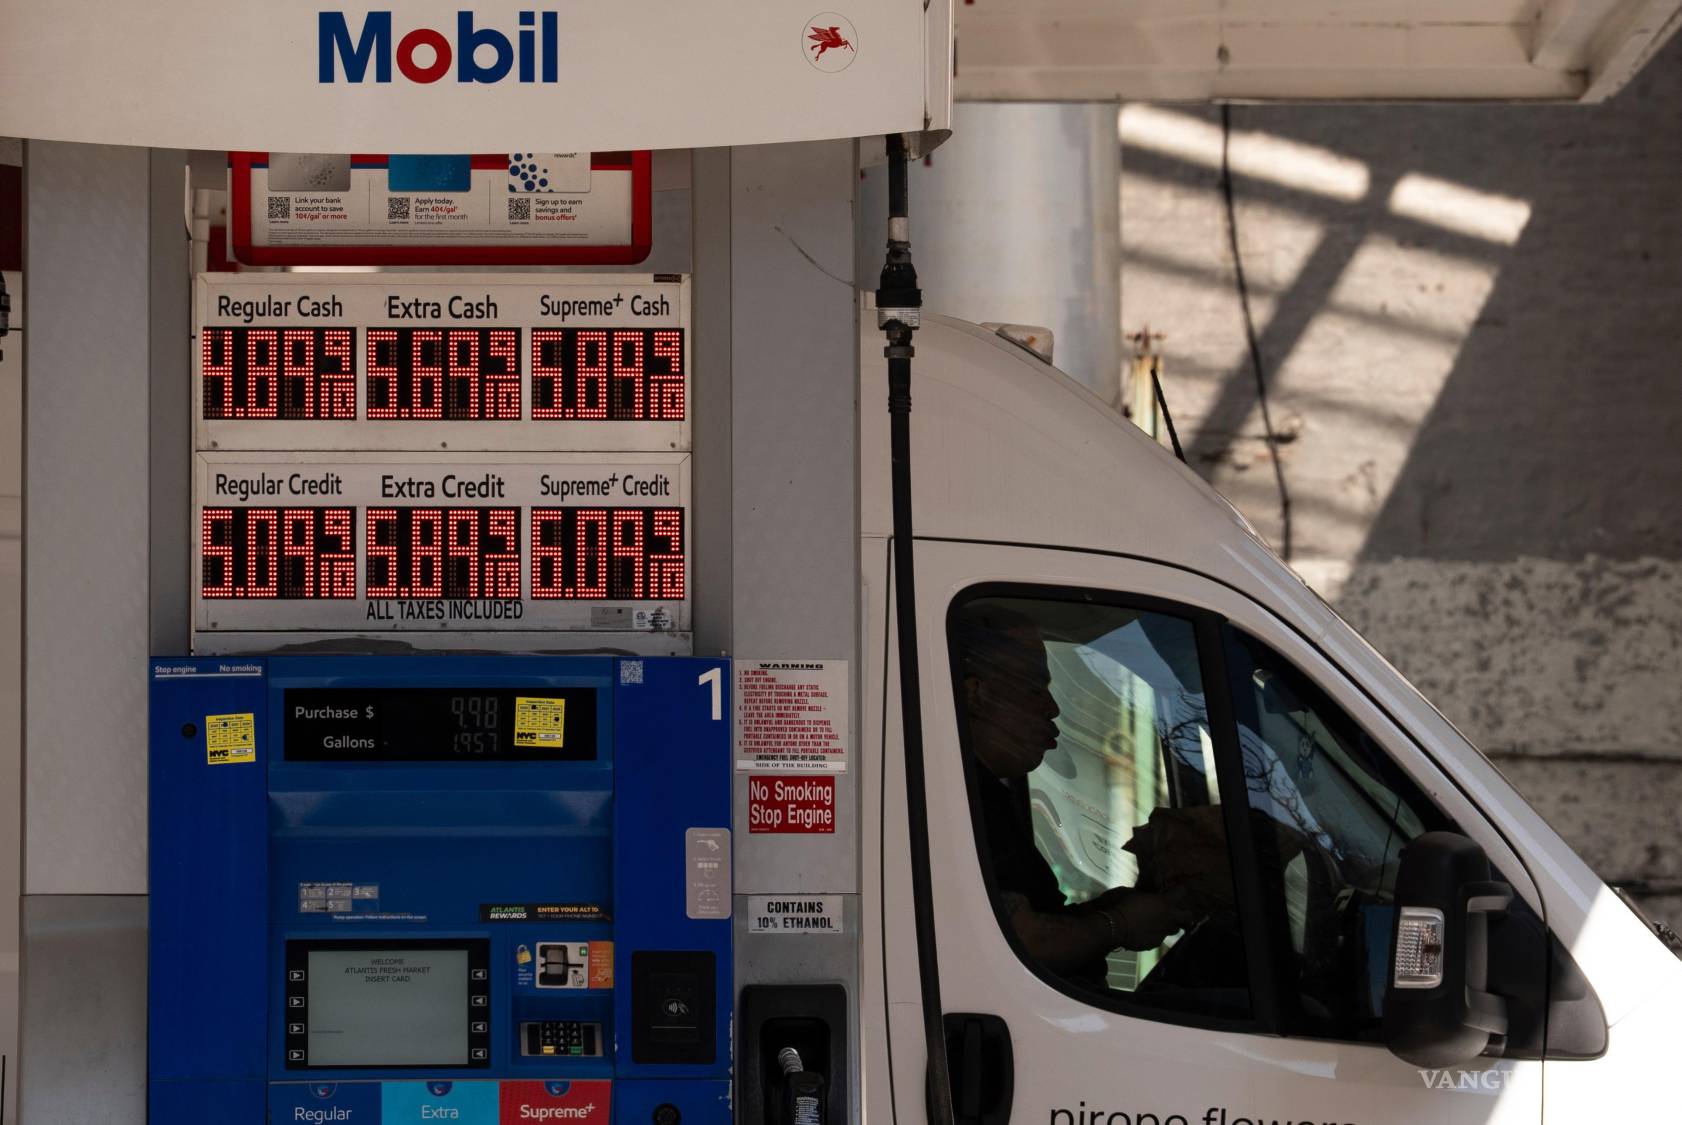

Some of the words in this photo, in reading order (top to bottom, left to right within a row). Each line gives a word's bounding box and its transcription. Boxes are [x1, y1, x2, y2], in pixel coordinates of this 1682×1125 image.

[319, 11, 558, 84] Mobil
[295, 196, 308, 204] Link
[326, 196, 341, 204] bank
[218, 295, 291, 323] Regular
[297, 295, 342, 317] Cash
[388, 296, 442, 319] Extra
[448, 296, 498, 319] Cash
[540, 292, 624, 321] Supreme+
[631, 294, 670, 316] Cash
[216, 473, 283, 501] Regular
[289, 473, 342, 495] Credit
[382, 475, 435, 498] Extra
[442, 474, 505, 498] Credit
[540, 473, 618, 501] Supreme+
[622, 474, 670, 496] Credit
[366, 602, 393, 620] ALL
[398, 601, 445, 620] TAXES
[449, 601, 523, 620] INCLUDED
[155, 666, 171, 674] Stop
[173, 666, 196, 674] engine
[232, 664, 262, 673] smoking
[699, 668, 721, 720] 1
[295, 706, 358, 719] Purchase
[366, 705, 374, 720] $
[323, 736, 375, 748] Gallons
[751, 781, 768, 801] No
[775, 781, 832, 805] Smoking
[751, 804, 782, 827] Stop
[788, 804, 832, 829] Engine
[767, 902, 823, 913] CONTAINS
[757, 917, 778, 928] 10%
[783, 917, 833, 928] ETHANOL
[295, 1107, 352, 1124] Regular
[422, 1105, 458, 1119] Extra
[520, 1103, 596, 1122] Supreme+
